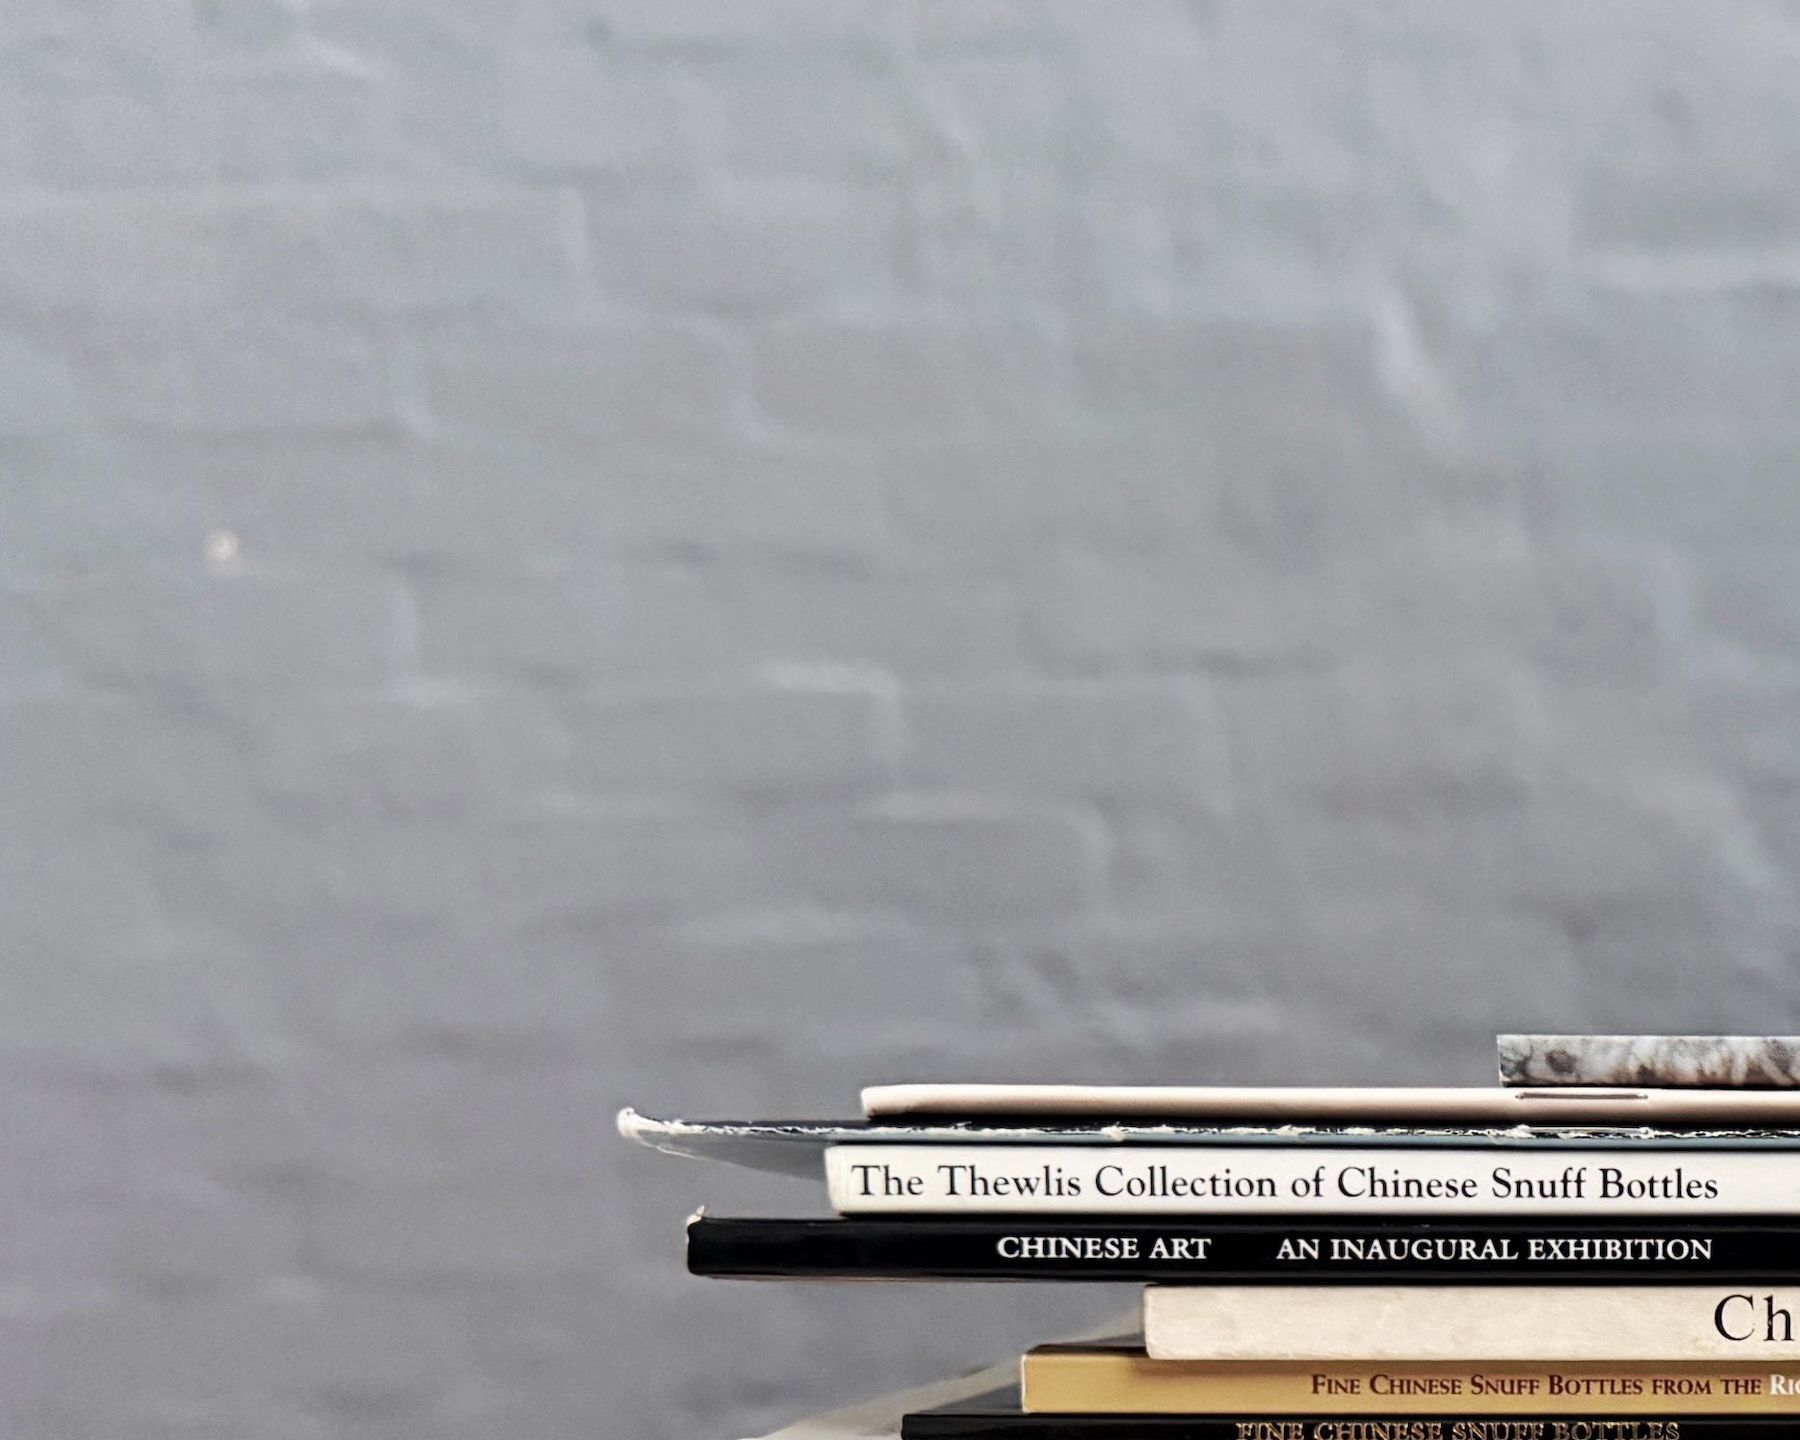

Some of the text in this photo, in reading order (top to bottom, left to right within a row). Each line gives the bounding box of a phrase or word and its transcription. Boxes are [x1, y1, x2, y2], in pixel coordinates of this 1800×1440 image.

[851, 1165, 1719, 1200] The Thewlis Collection of Chinese Snuff Bottles
[997, 1236, 1212, 1260] CHINESE ART
[1276, 1237, 1713, 1262] AN INAUGURAL EXHIBITION
